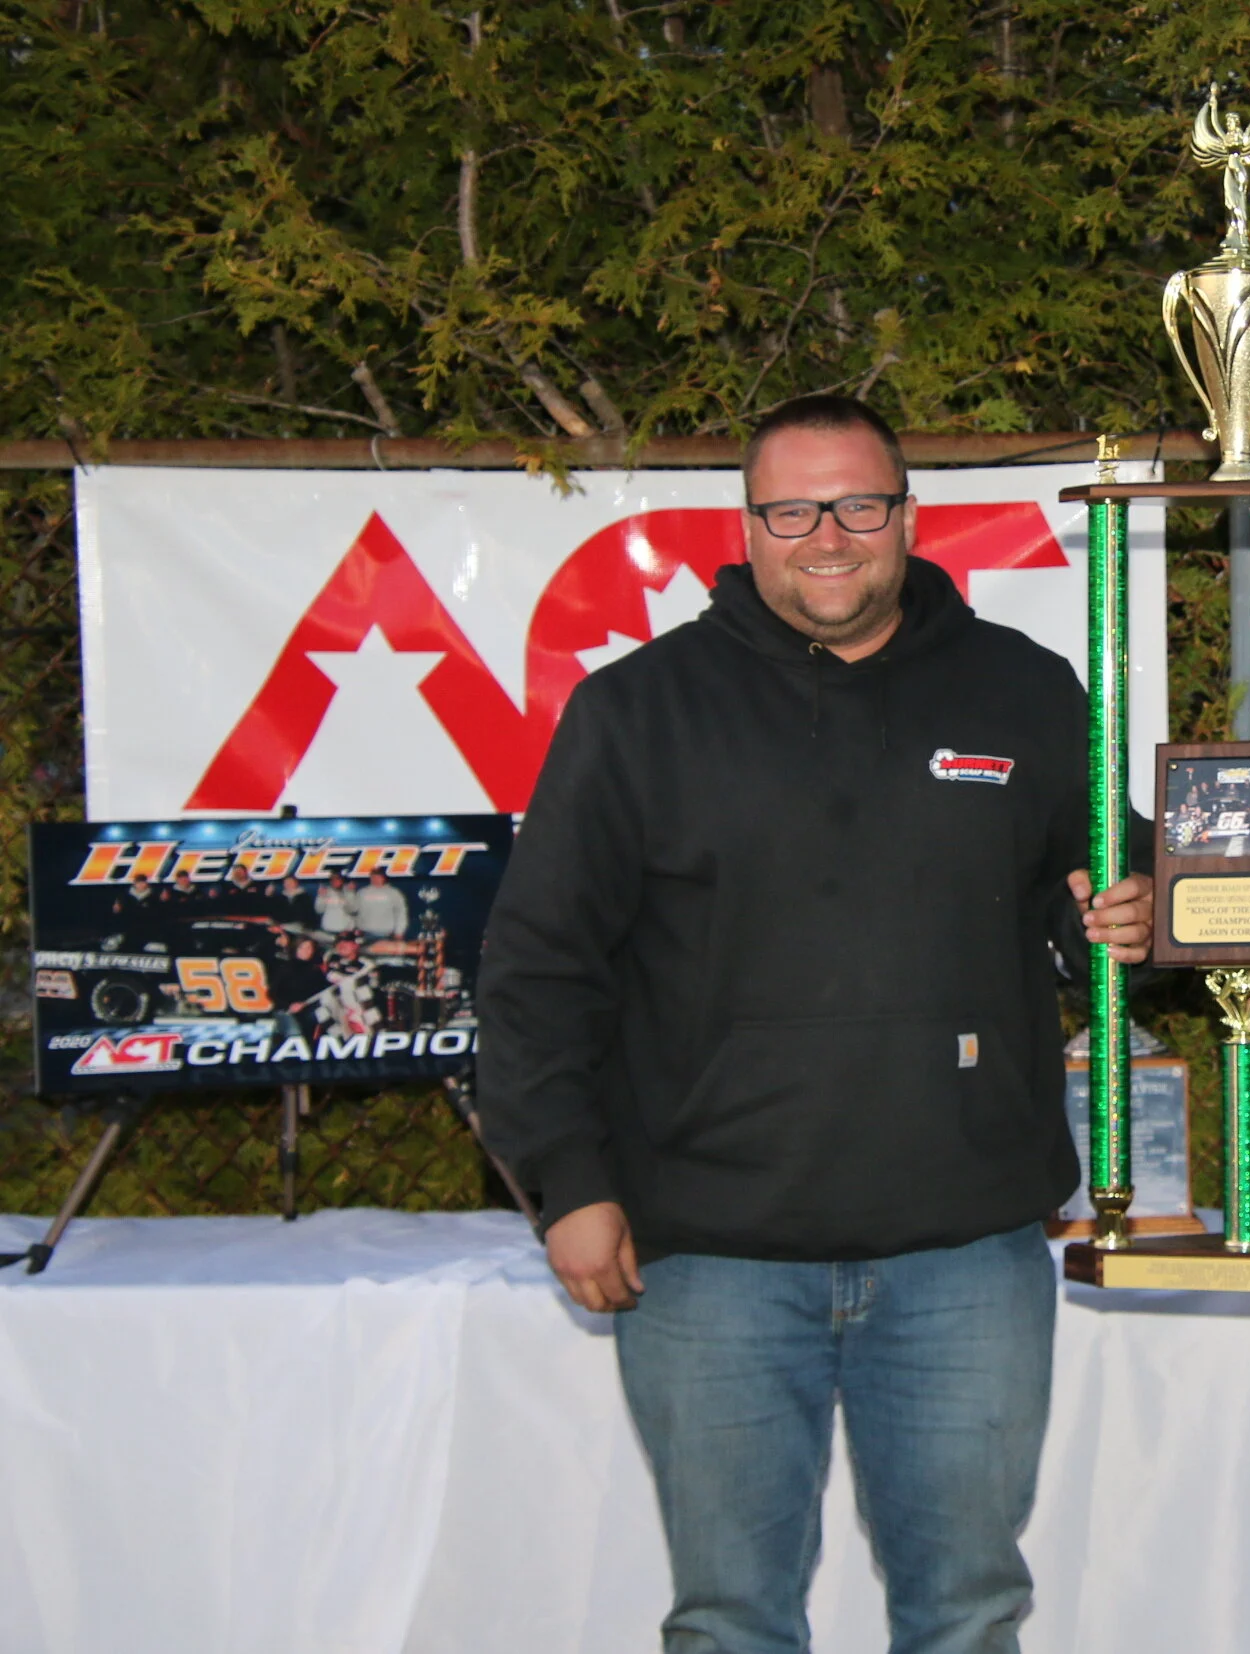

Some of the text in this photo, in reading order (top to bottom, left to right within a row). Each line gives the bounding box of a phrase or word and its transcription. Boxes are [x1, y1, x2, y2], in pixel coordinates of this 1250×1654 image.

[1096, 434, 1120, 459] 1st
[68, 841, 489, 885] HEBERT
[175, 957, 274, 1013] 58
[48, 1034, 92, 1050] 2020
[186, 1029, 478, 1067] CHAMPIO
